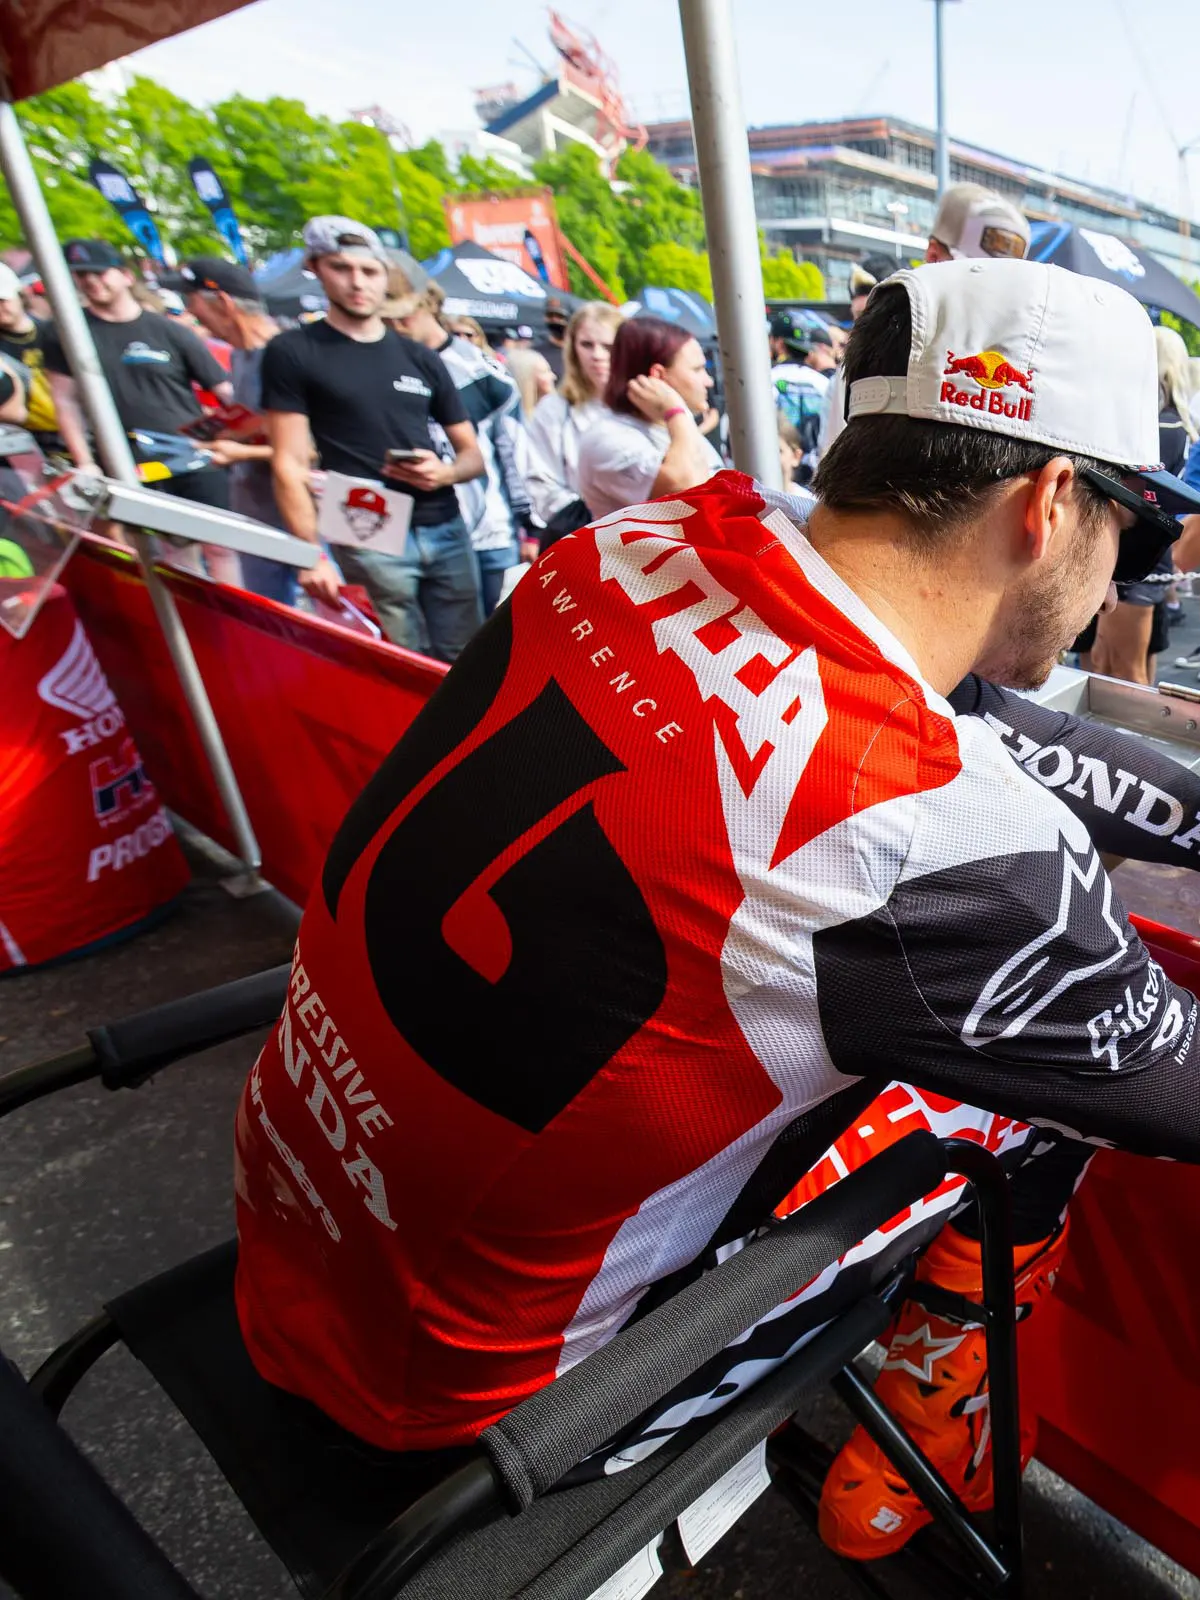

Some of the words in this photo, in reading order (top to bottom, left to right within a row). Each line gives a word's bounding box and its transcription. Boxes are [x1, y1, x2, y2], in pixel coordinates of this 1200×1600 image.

[940, 381, 987, 411] Red
[988, 391, 1033, 422] Bull
[537, 551, 685, 745] LAWRENCE
